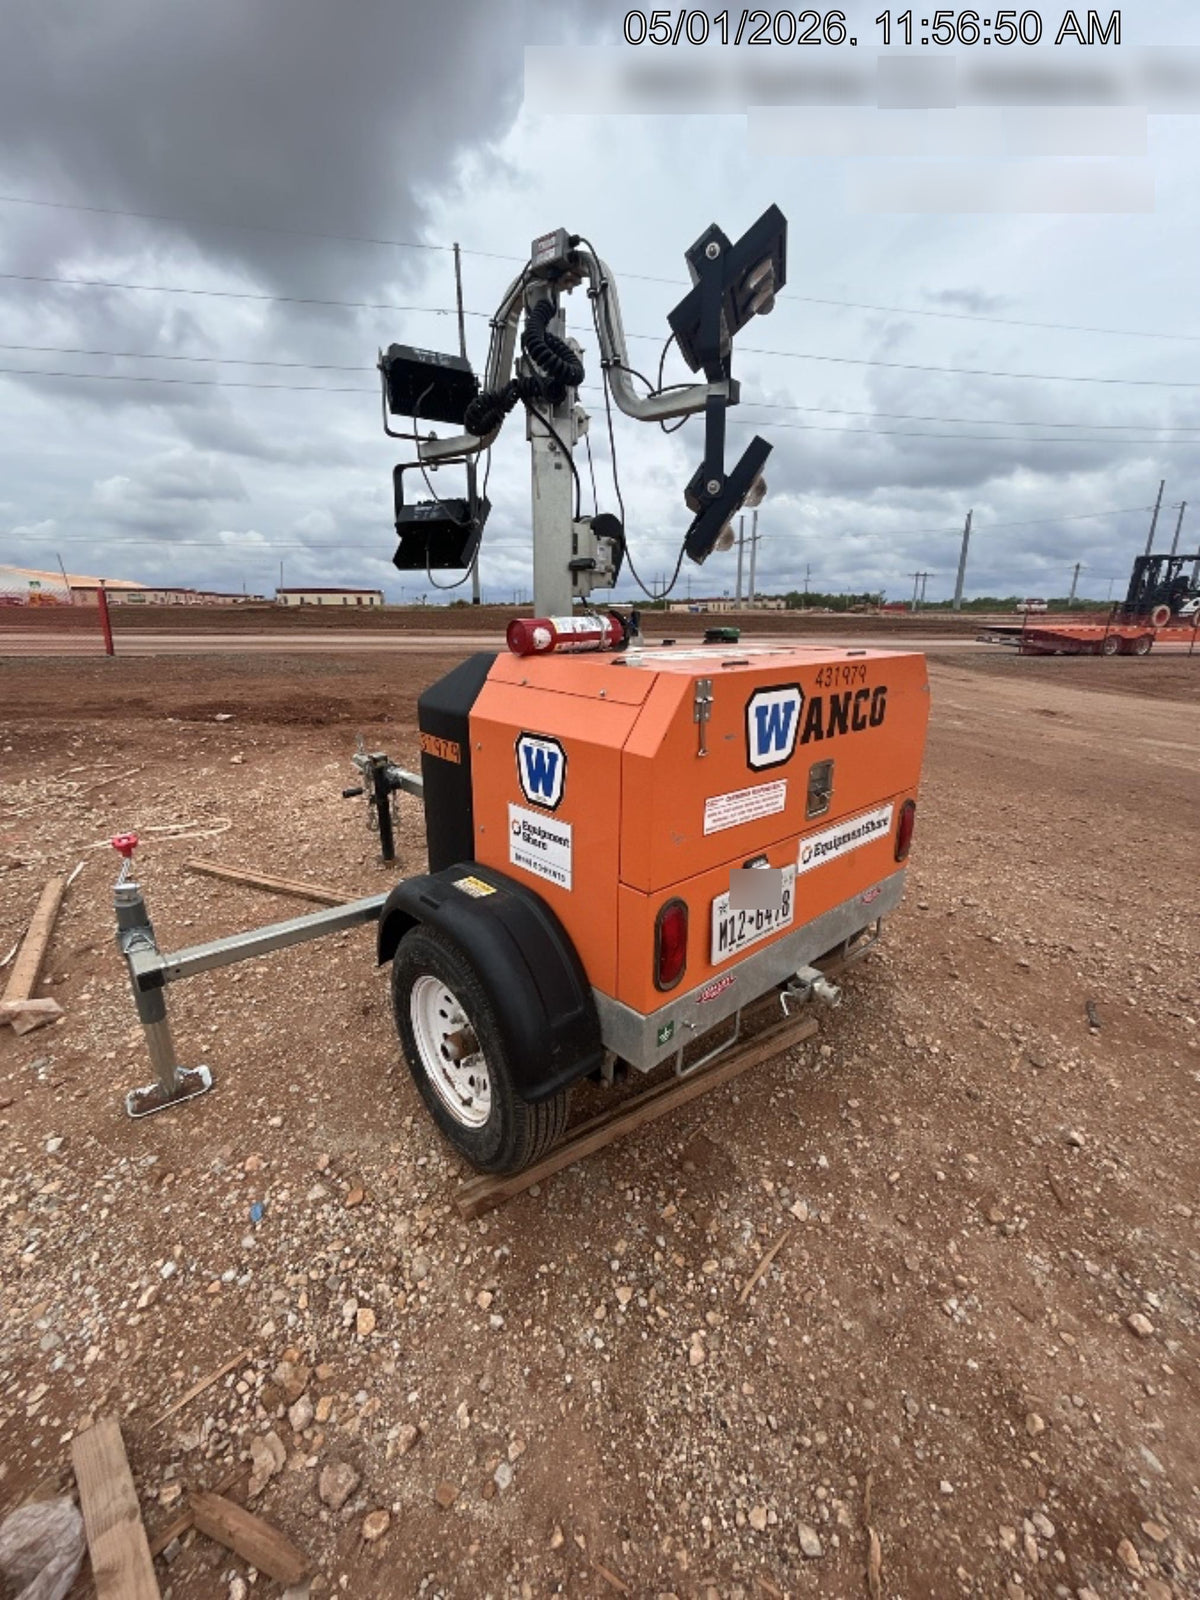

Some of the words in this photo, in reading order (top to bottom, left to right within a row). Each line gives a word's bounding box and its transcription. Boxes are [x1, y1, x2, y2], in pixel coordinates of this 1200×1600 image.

[815, 665, 867, 688] 431979
[421, 733, 460, 762] 3979
[523, 744, 559, 798] W
[522, 820, 570, 848] Equipment
[522, 832, 548, 851] Share
[813, 817, 890, 858] EquipmentShare
